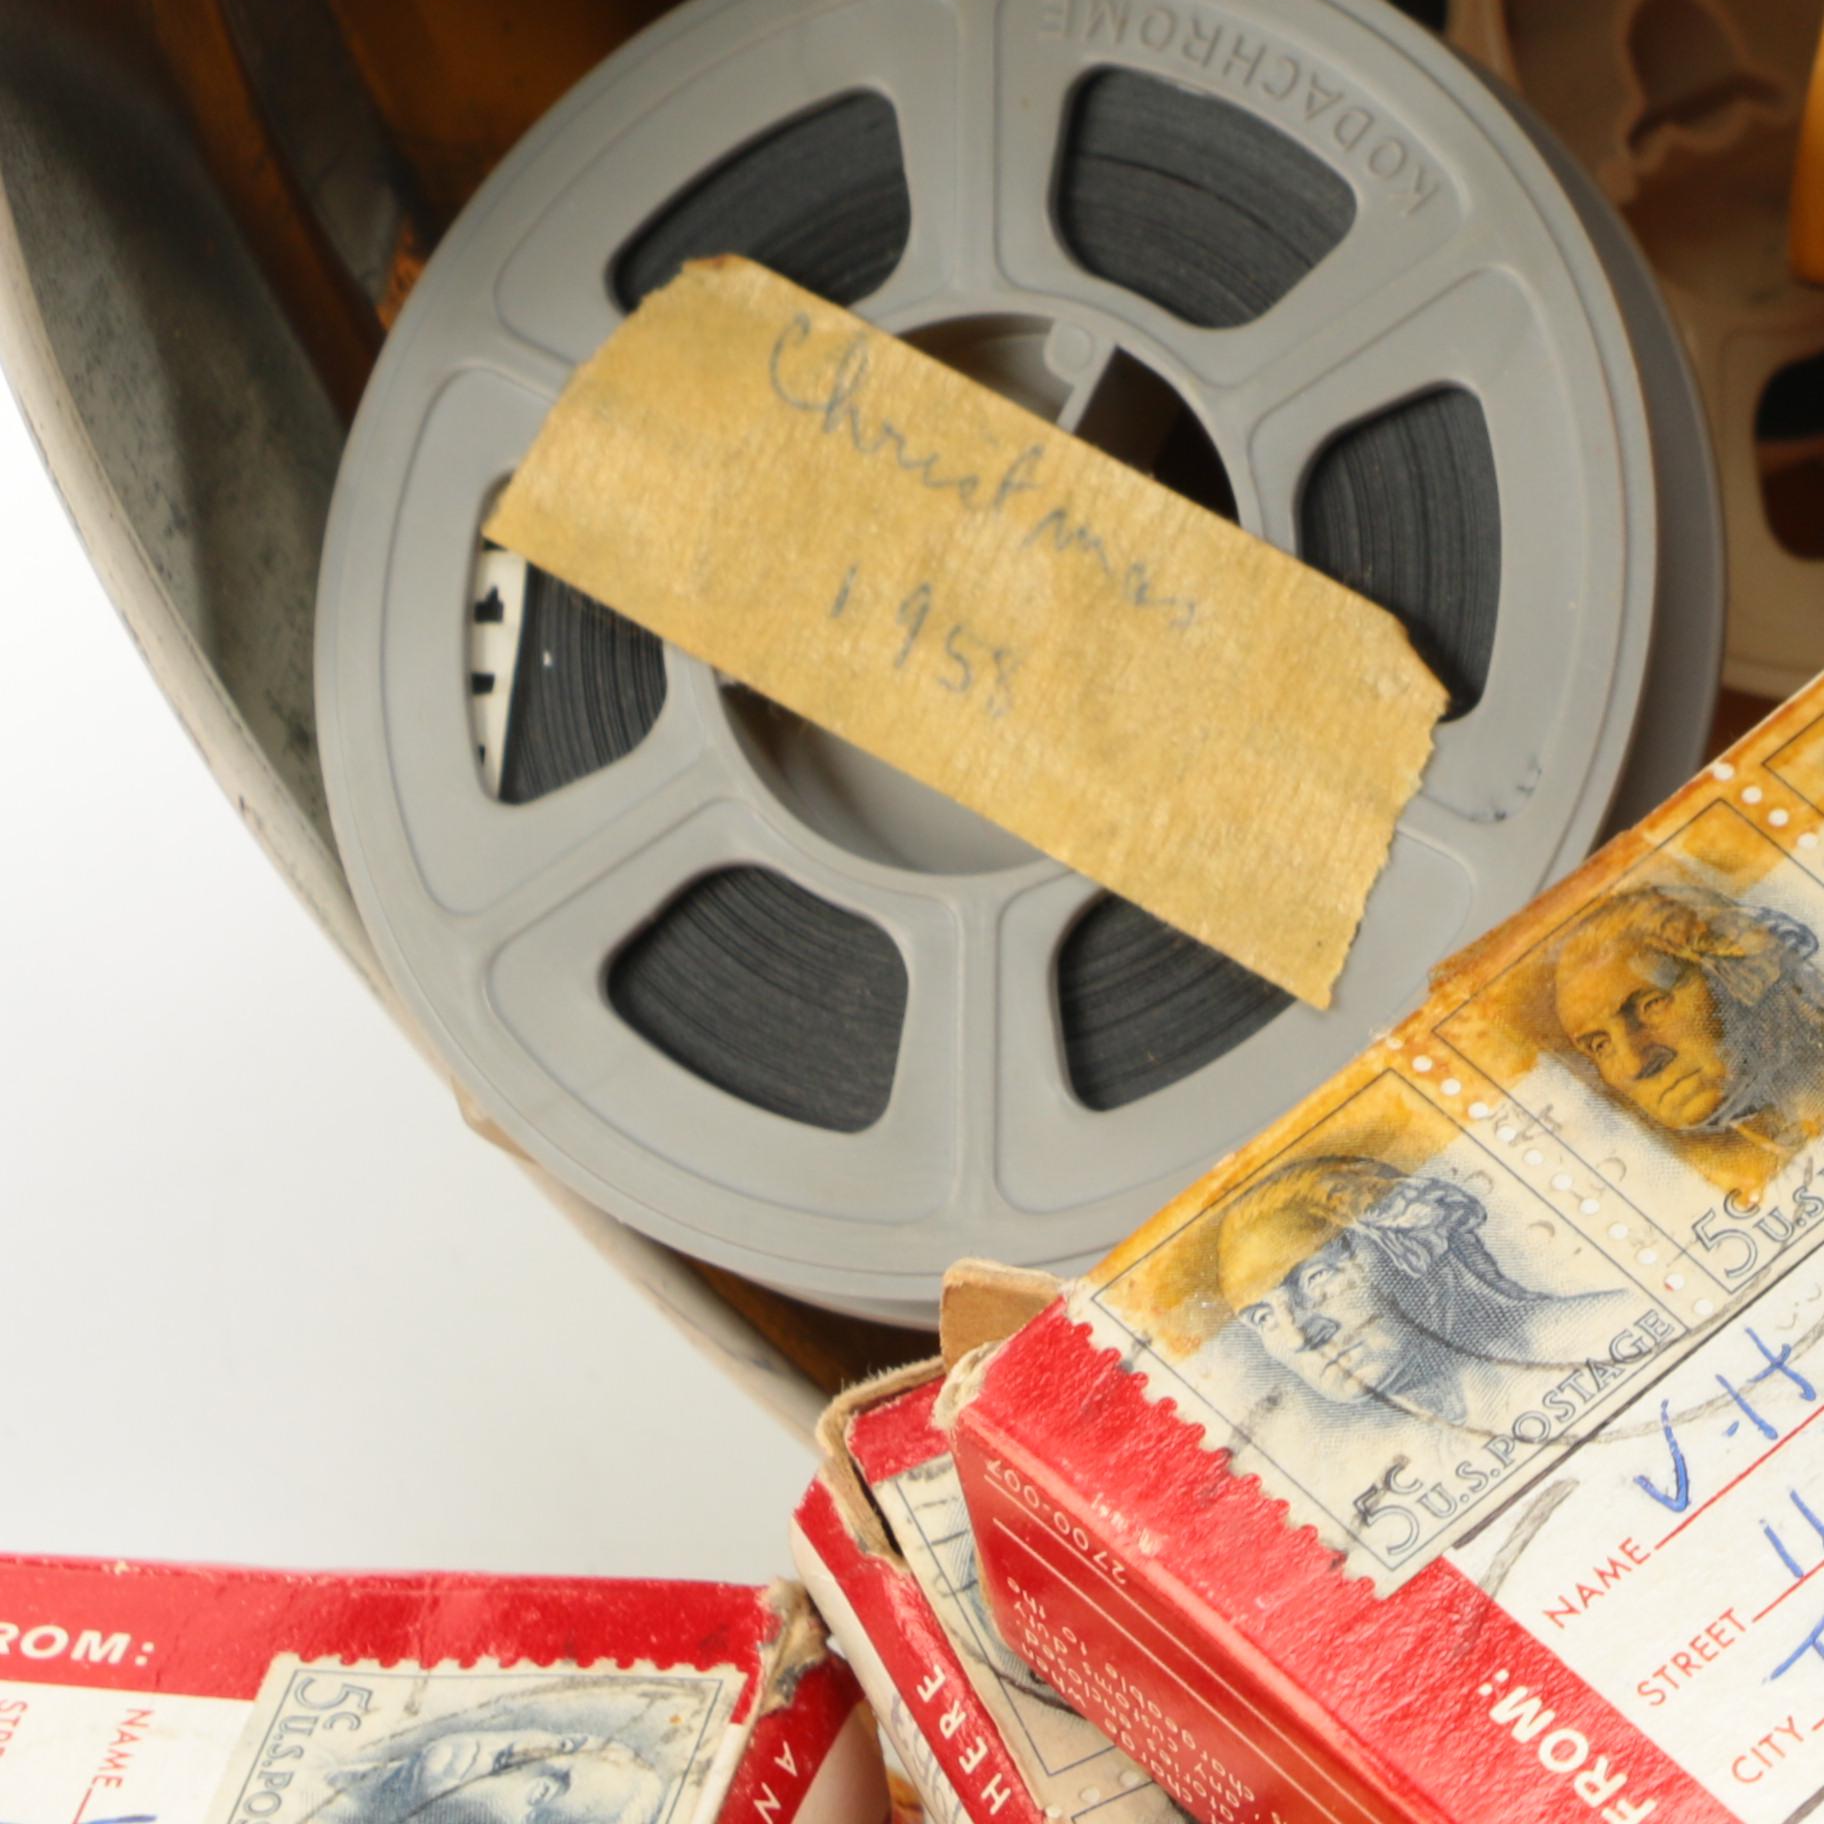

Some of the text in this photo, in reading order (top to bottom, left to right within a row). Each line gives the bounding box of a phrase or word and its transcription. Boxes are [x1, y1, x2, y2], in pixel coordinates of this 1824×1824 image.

[766, 308, 1208, 631] Christmas
[828, 562, 1013, 716] 1958
[988, 1459, 1128, 1585] 2700-007
[1543, 1536, 1651, 1629] NAME
[1014, 1617, 1133, 1732] enclosed.
[1061, 1625, 1087, 1657] to
[1636, 1607, 1746, 1706] STREET
[92, 1707, 155, 1789] NAME
[916, 1664, 1012, 1816] HERE
[1082, 1660, 1178, 1753] customs
[1104, 1661, 1255, 1804] chargeable
[1731, 1715, 1804, 1785] CITY
